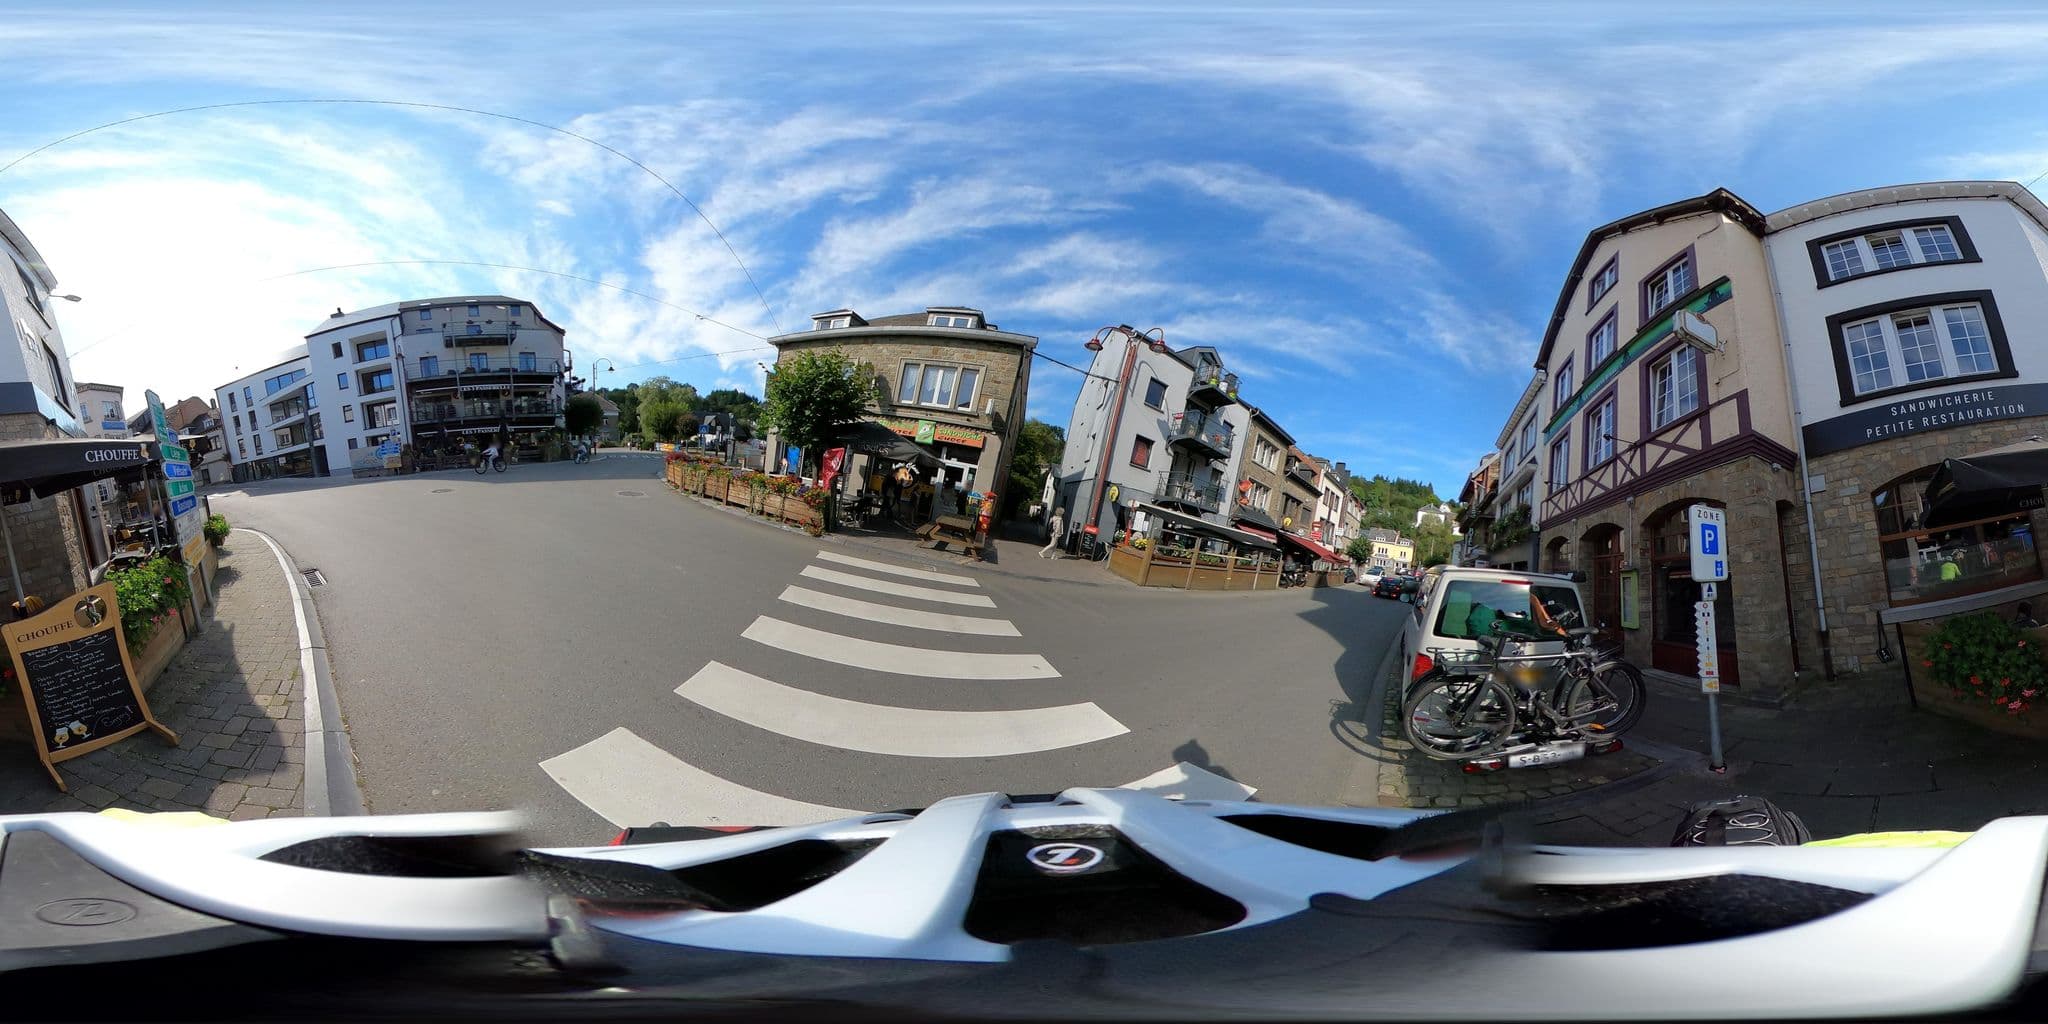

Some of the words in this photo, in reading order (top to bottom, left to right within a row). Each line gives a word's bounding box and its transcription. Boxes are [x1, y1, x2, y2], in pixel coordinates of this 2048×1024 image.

[1890, 391, 1995, 416] SANDWICHERIE
[1866, 419, 1915, 439] PETITE
[1922, 403, 2025, 427] RESTAURATION
[85, 449, 139, 463] CHOUFFE
[1697, 509, 1720, 521] ZONE
[17, 620, 74, 643] CHOUFFE
